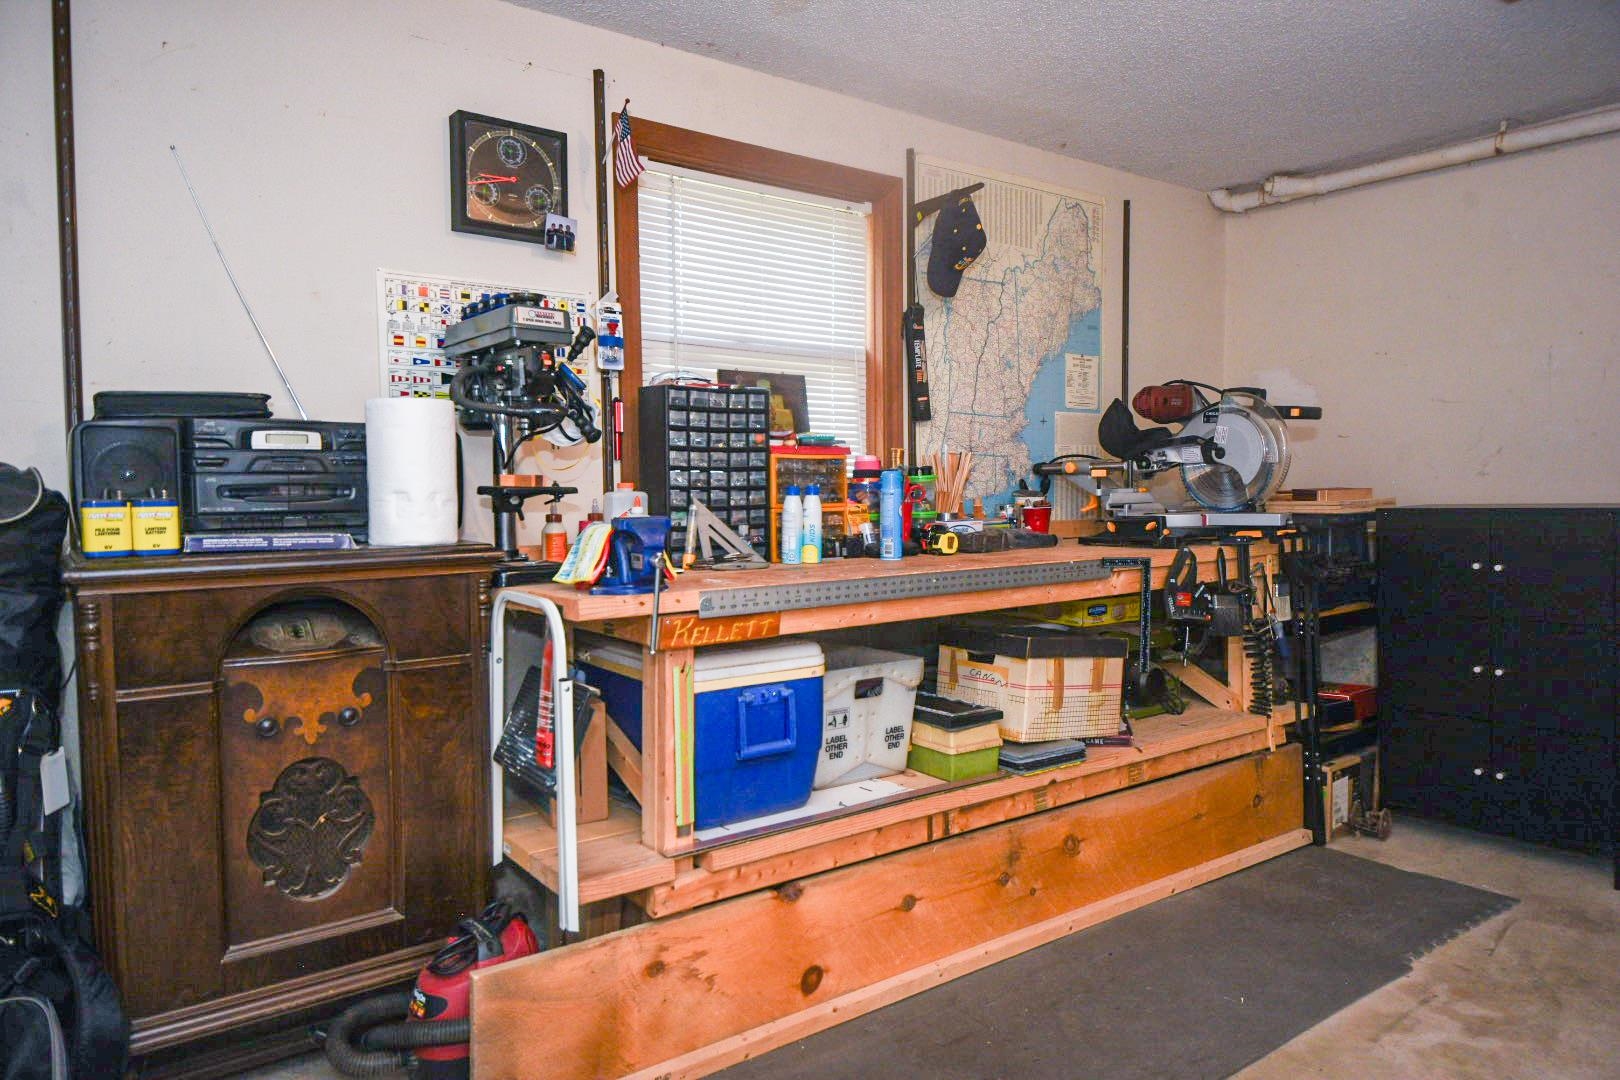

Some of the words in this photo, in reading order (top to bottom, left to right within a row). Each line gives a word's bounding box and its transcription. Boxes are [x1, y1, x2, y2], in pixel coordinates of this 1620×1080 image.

[670, 618, 774, 647] KELLETT
[969, 668, 1008, 688] CANON
[885, 725, 904, 735] LABEL
[825, 735, 848, 745] LABEL
[884, 733, 905, 742] OTHER
[825, 742, 848, 752] OTHER
[887, 741, 900, 749] END
[829, 751, 844, 760] END
